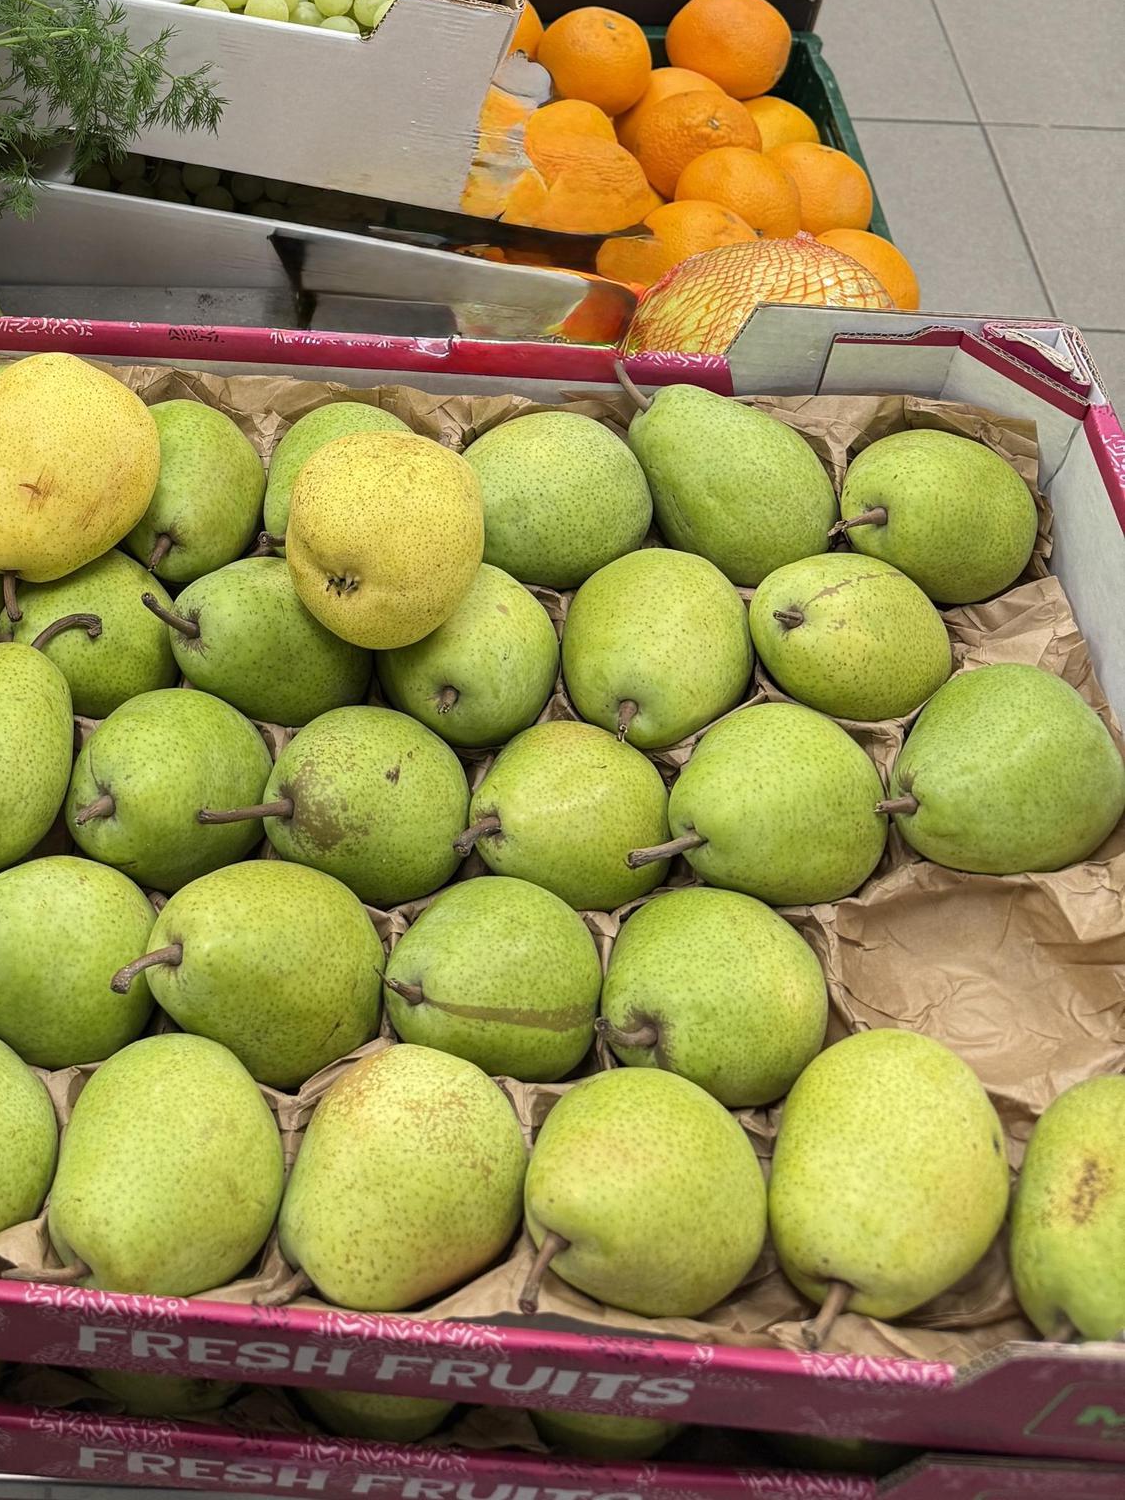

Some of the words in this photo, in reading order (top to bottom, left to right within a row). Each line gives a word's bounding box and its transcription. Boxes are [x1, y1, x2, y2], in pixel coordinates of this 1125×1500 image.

[78, 1324, 355, 1376] FRESH
[375, 1353, 697, 1406] FRUITS
[78, 1446, 332, 1492] FRESH
